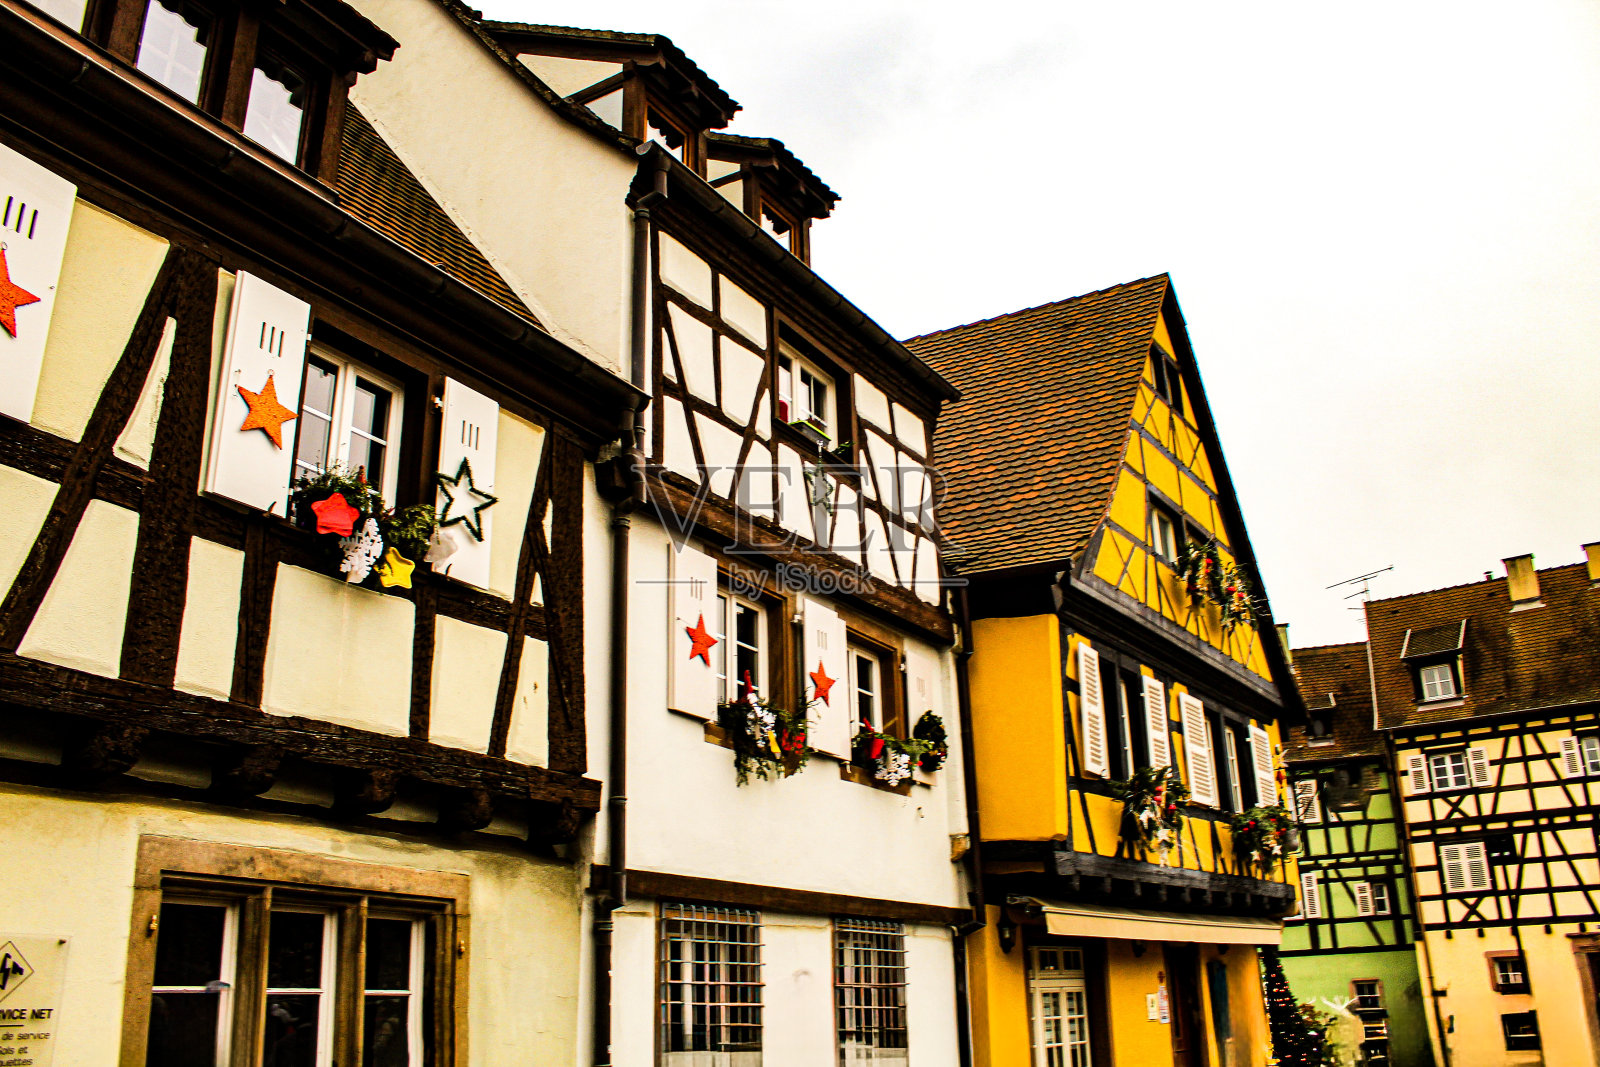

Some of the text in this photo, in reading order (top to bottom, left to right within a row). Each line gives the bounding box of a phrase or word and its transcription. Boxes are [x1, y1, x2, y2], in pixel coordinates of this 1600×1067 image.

[0, 1008, 54, 1020] VICE NET
[2, 1032, 50, 1040] de service
